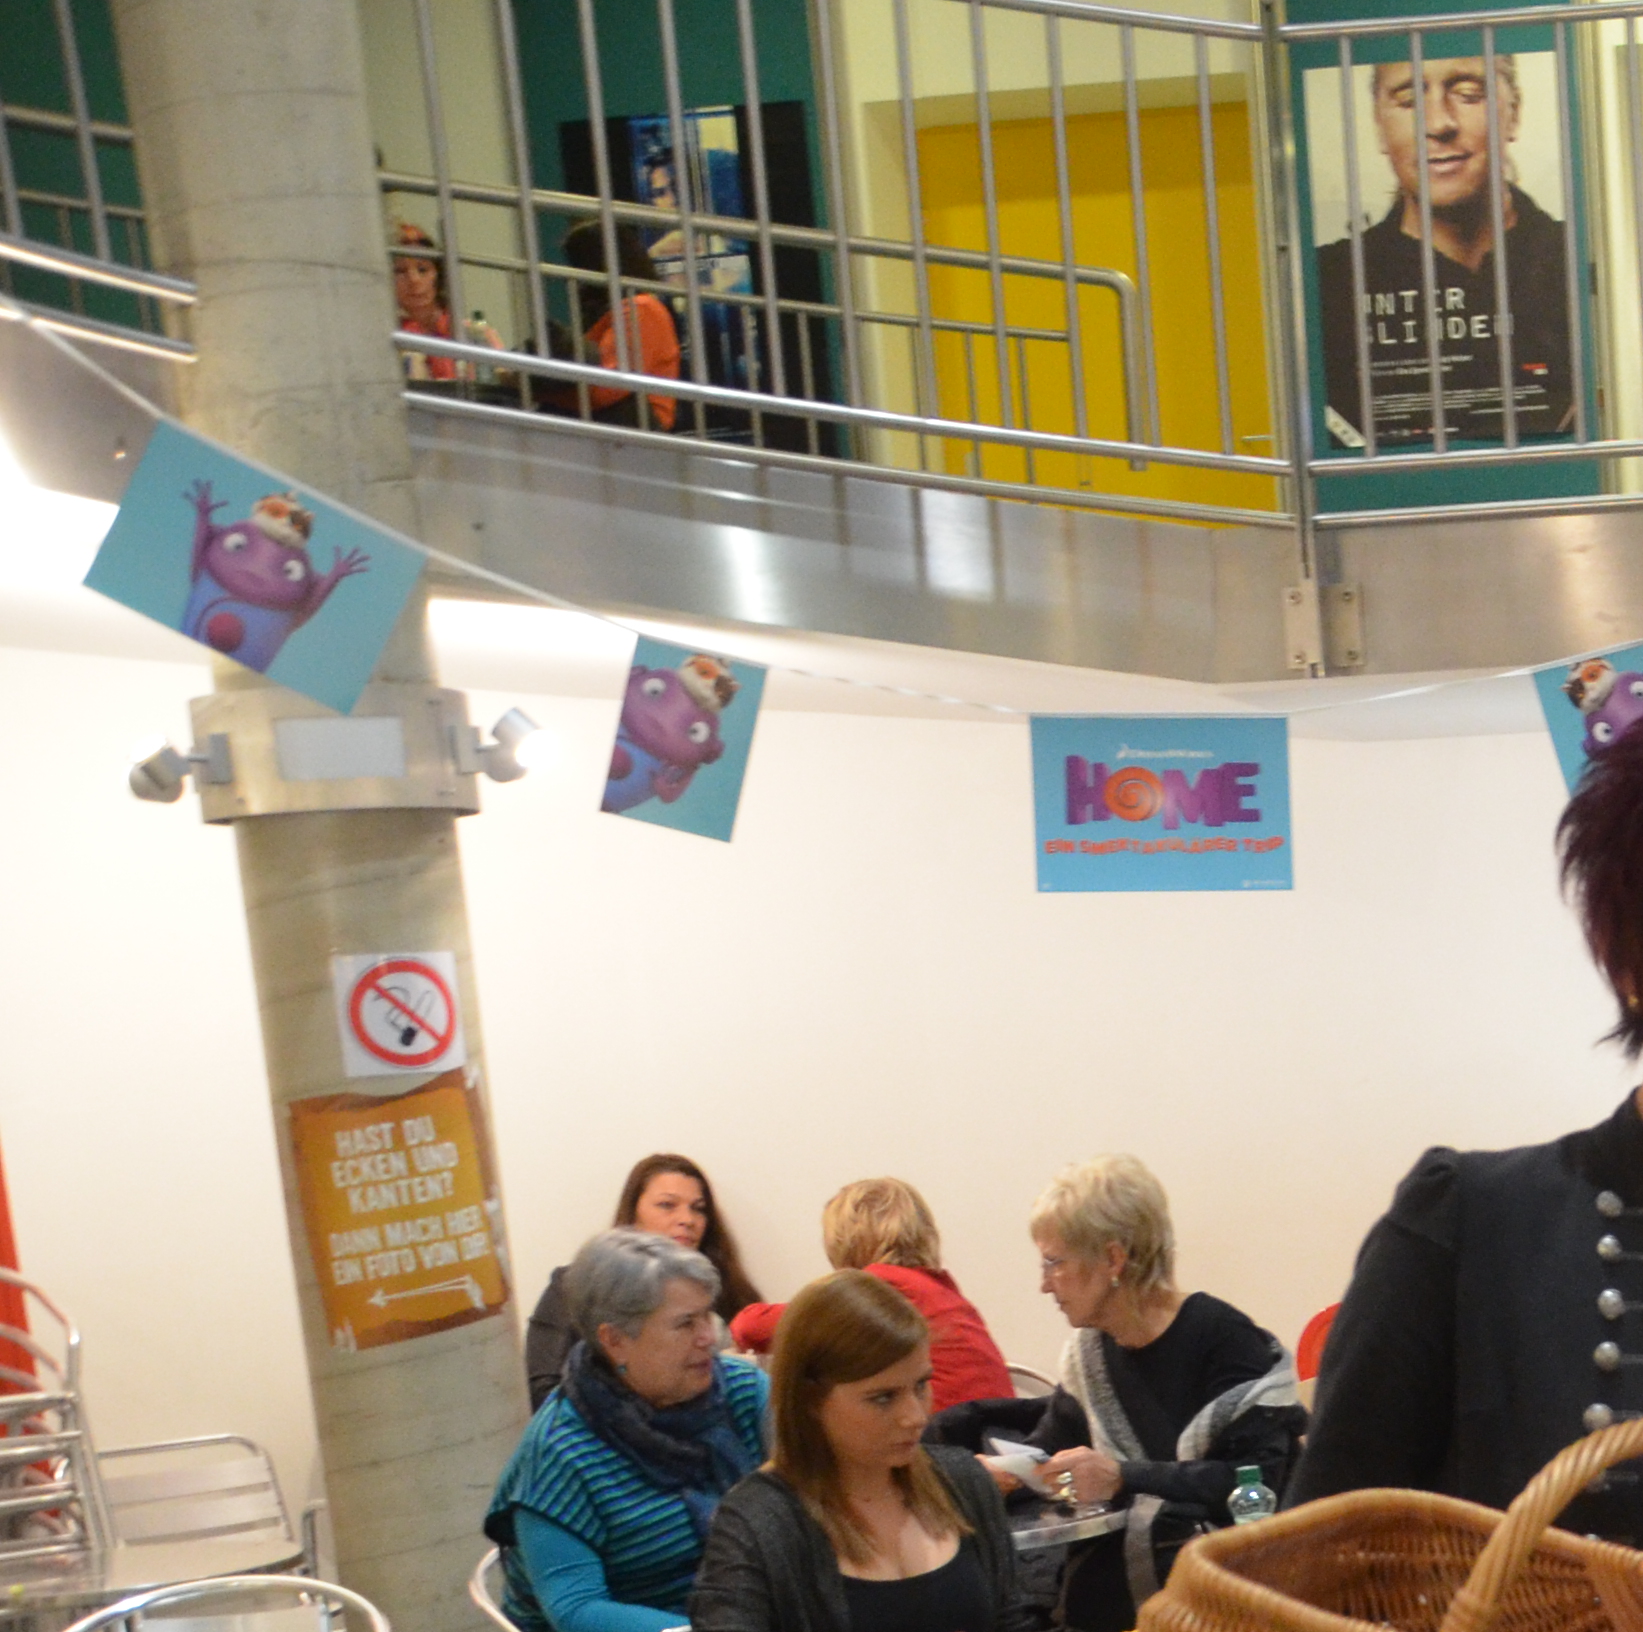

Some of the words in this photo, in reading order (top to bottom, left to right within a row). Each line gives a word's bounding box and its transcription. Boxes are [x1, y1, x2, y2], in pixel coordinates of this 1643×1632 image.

[336, 1123, 394, 1156] HAST
[402, 1115, 436, 1144] DU
[332, 1151, 408, 1188] ECKEN
[412, 1142, 459, 1173] UND
[349, 1173, 454, 1213] KANTEN?
[328, 1226, 381, 1258] DANN
[384, 1215, 444, 1247] MACH
[331, 1258, 364, 1286] EIN
[366, 1249, 416, 1279] FOTO
[418, 1239, 460, 1270] VON
